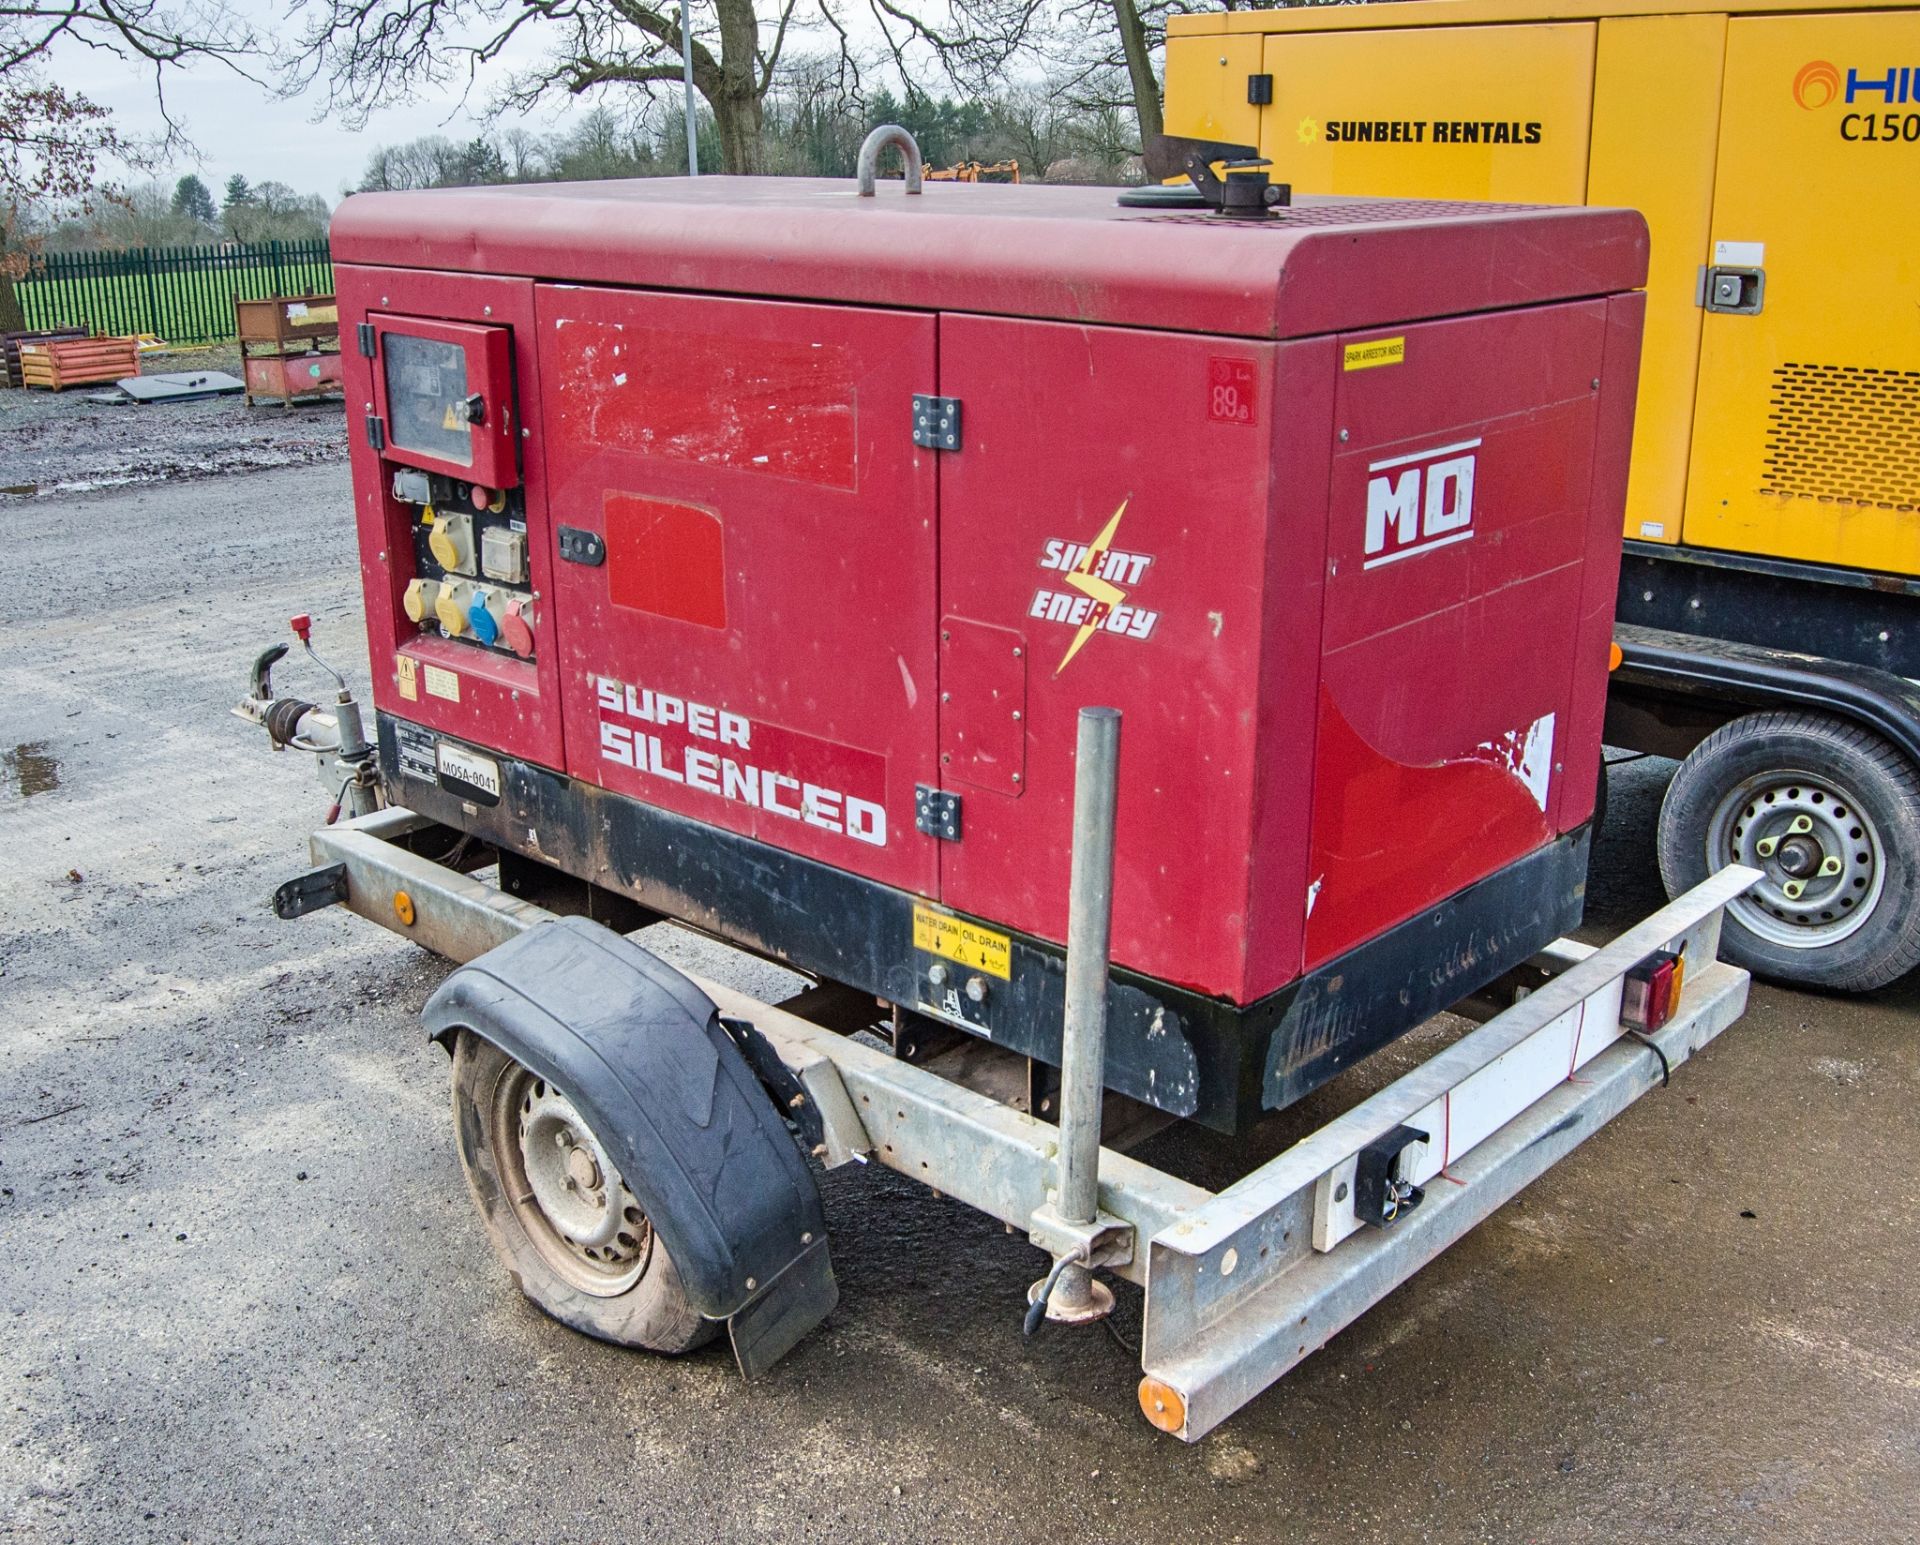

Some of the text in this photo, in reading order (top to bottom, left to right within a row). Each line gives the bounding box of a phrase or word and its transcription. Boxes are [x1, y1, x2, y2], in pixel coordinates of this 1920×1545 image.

[1845, 68, 1920, 103] HI
[1325, 121, 1542, 144] SUNBELT RENTALS
[1040, 540, 1151, 585] SILENT
[1030, 590, 1157, 640] ENERGY
[597, 676, 750, 750] SUPER
[442, 760, 497, 792] MOSA-0041
[600, 720, 887, 847] SILENCED
[916, 912, 959, 936] WATER DRAIN
[962, 929, 1007, 953] OIL DRAIN
